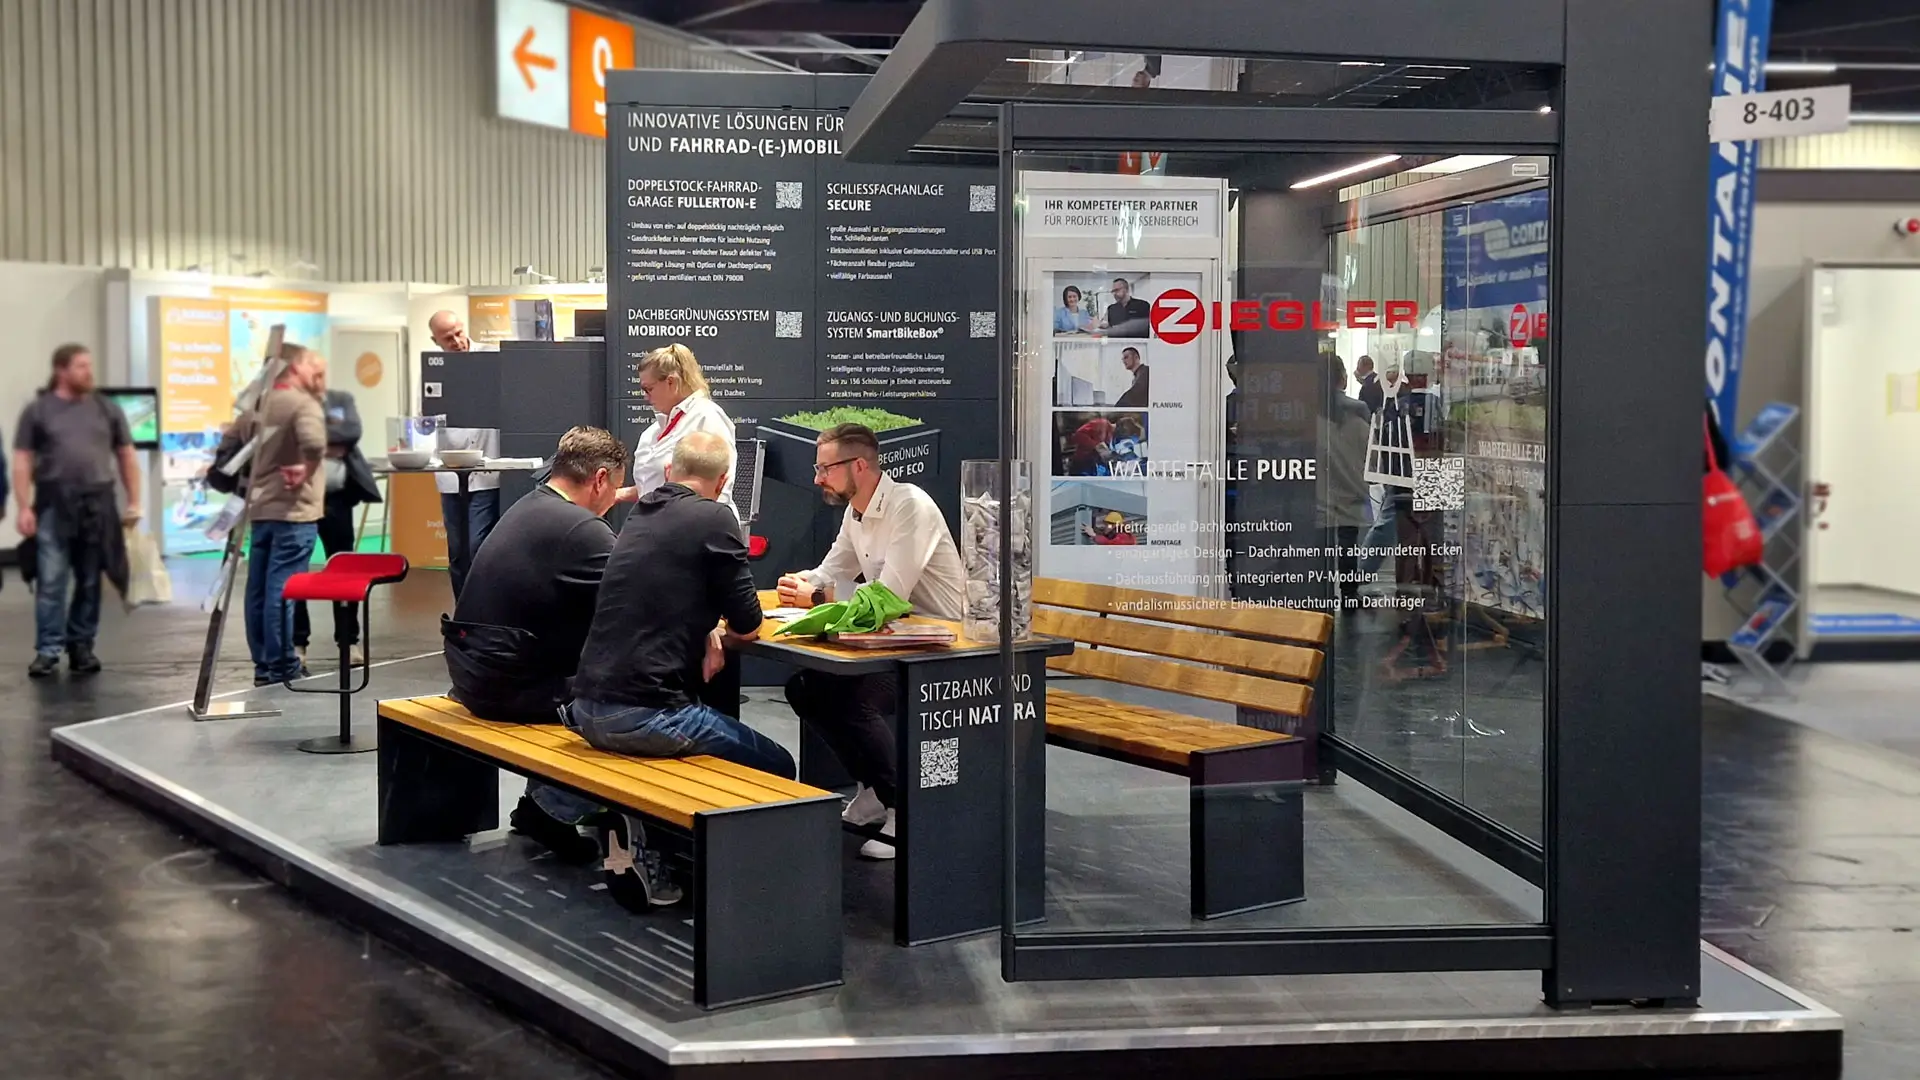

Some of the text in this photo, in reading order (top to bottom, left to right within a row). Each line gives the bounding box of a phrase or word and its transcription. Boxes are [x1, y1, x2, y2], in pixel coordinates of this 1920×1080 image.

[1743, 97, 1816, 124] 8-403
[627, 112, 845, 132] INNOVATIVE LÖSUNGEN FÜR
[628, 137, 662, 152] UND
[628, 179, 763, 194] DOPPELSTOCK-FAHRRAD-
[827, 183, 944, 197] SCHLIESSFACHANLAGE
[627, 195, 757, 210] GARAGE FULLERTON-E
[827, 199, 872, 212] SECURE
[1044, 200, 1198, 212] IHR KOMPETENTER PARTNER
[1044, 214, 1062, 226] FÜR
[1065, 215, 1109, 226] PROJEKTE
[628, 307, 770, 321] DACHBEGRÜNUNGSSYSTEM
[827, 311, 961, 323] ZUGANGS- UND BUCHUNGS-
[1151, 289, 1418, 345] ZIEGLER
[628, 325, 718, 337] MOBIROOF ECO
[827, 327, 945, 339] SYSTEM SmartBikeBox®
[737, 376, 763, 386] Wirkung
[712, 389, 746, 397] des Daches
[1152, 401, 1183, 409] PLANUNG
[878, 444, 929, 466] BEGRÜNUNG
[906, 461, 925, 476] ECO
[1108, 459, 1317, 481] WARTEHALLE PURE
[1115, 518, 1292, 538] freitragende Dachkonstruktion
[1193, 546, 1233, 561] Design
[1248, 544, 1321, 559] Dachrahmen
[1324, 544, 1344, 558] mit
[1346, 544, 1427, 560] abgerundeten
[1430, 543, 1464, 557] Ecken
[1115, 570, 1378, 587] Dachausführung mit integrierten PV-Modulen
[1115, 595, 1426, 612] vandalismussichere Einbaubeleuchtung im Dachträger
[920, 673, 1032, 703] SITZBANK ND
[919, 701, 1037, 732] TISCH NATRA
